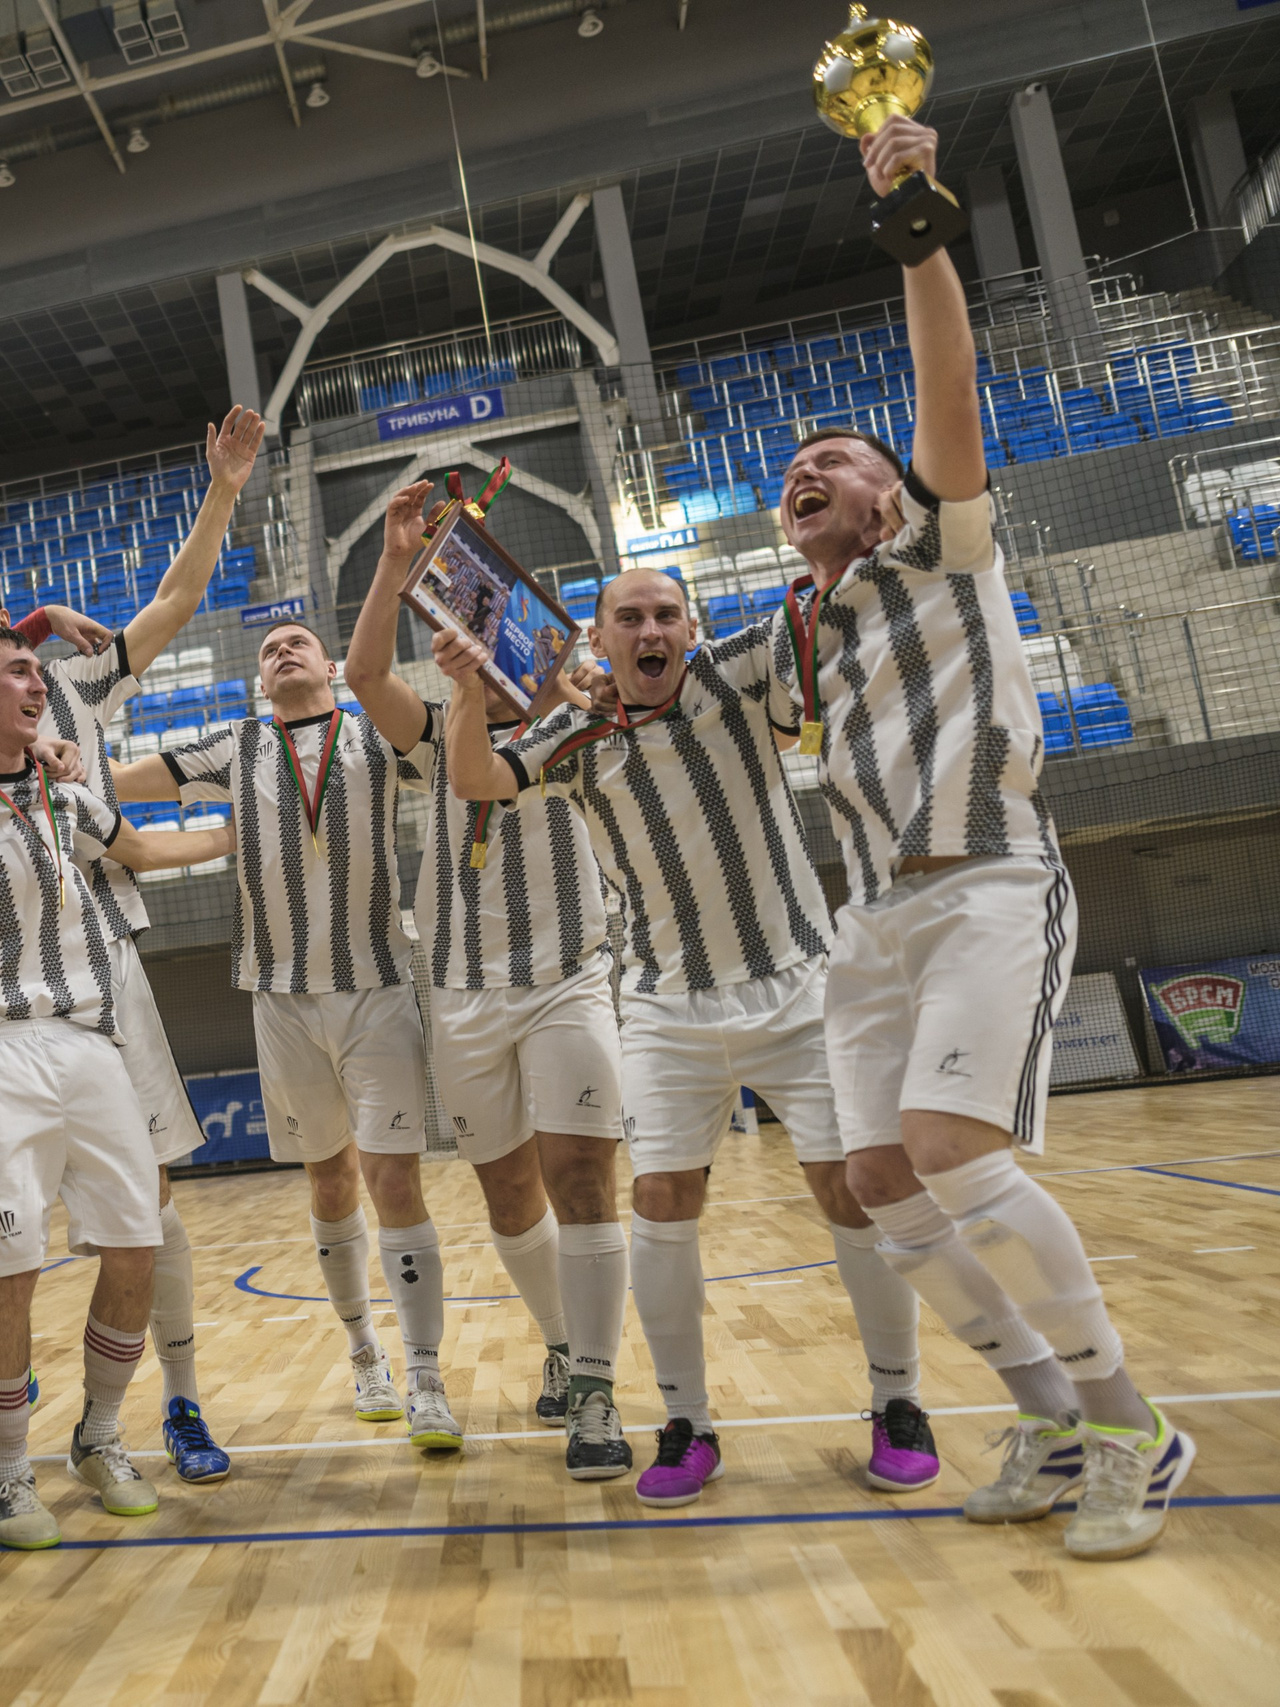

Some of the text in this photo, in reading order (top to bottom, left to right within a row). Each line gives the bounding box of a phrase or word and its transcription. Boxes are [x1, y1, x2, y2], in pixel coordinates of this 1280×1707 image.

[386, 394, 493, 432] ТРИБУНА D
[504, 616, 535, 650] ПЕРВОЕ
[504, 628, 531, 657] МЕСТО
[1168, 984, 1235, 1011] БРСМ
[1053, 1033, 1120, 1050] омитет
